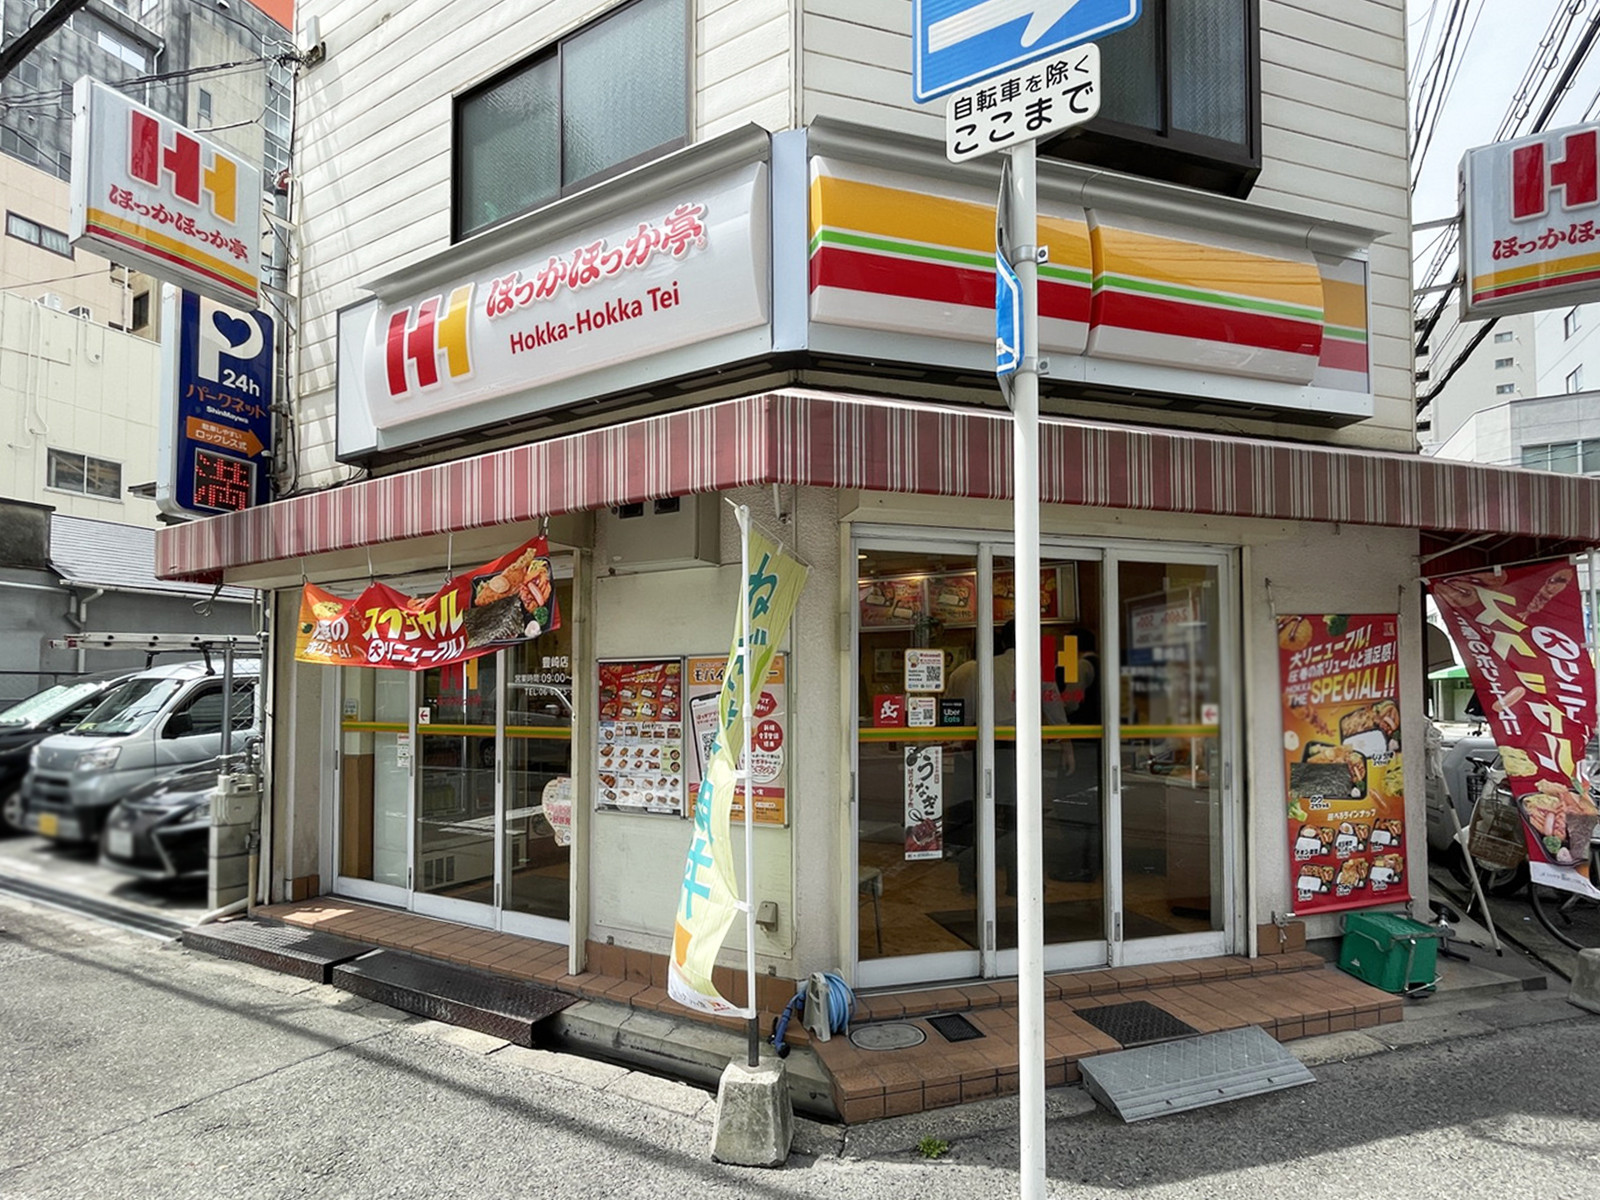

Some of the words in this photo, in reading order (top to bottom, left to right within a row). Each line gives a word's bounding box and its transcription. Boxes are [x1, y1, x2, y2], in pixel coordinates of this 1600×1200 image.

[954, 55, 1089, 121] 自転車を除く
[953, 81, 1094, 154] ここまで
[108, 184, 249, 263] ほっかほっか亭
[1492, 220, 1600, 261] ほっかほ
[485, 202, 708, 318] ほっかほっか亭
[510, 297, 643, 355] Hokka-Hokka
[647, 281, 680, 313] Tei
[186, 383, 267, 419] パークネット
[222, 369, 260, 397] 24h
[206, 405, 249, 424] ShinMaywa
[195, 430, 248, 451] ロックレス式
[1289, 624, 1372, 670] 大リニューアル!
[1288, 693, 1308, 706] THE
[1310, 664, 1396, 704] SPECIAL!!
[943, 708, 961, 716] Uber
[915, 754, 938, 816] うなぎ
